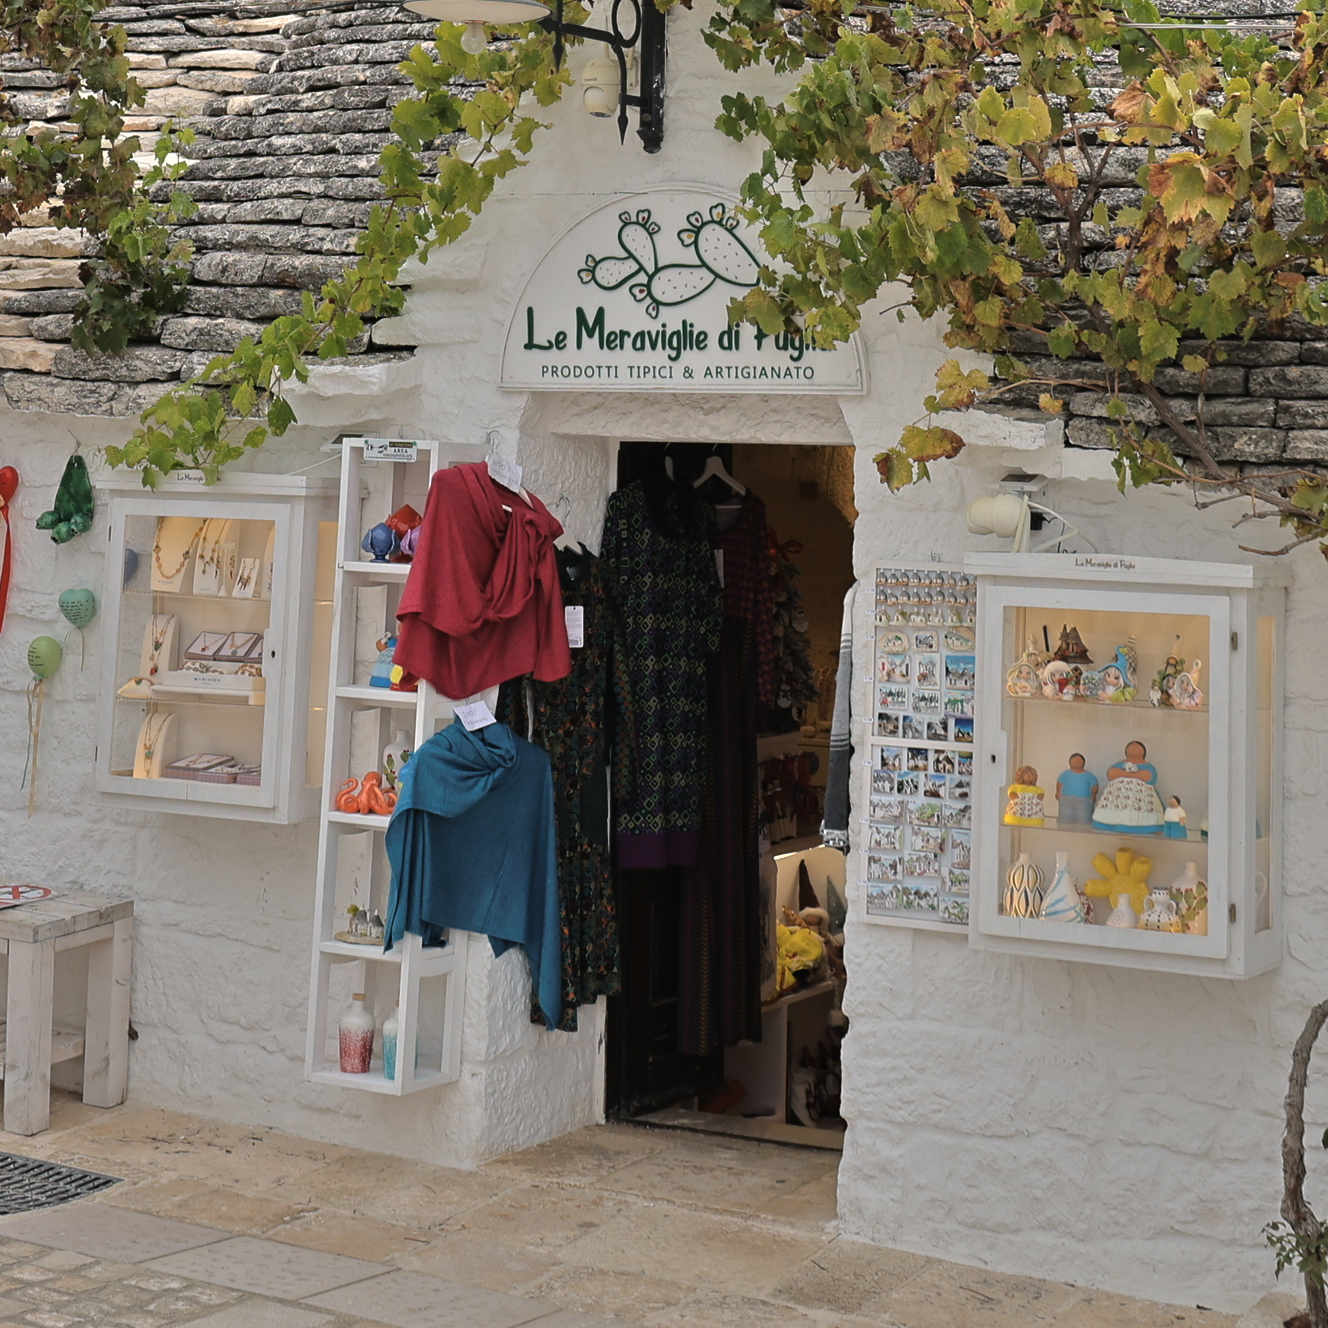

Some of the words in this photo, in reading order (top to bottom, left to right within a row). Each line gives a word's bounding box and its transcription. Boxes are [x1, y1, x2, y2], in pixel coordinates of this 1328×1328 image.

[524, 306, 567, 350] Le
[576, 306, 708, 361] Meraviglie
[718, 321, 740, 351] di
[754, 320, 834, 362] Pug
[541, 365, 618, 378] PRODOTTI
[628, 365, 673, 379] TIPICI
[683, 366, 694, 379] &
[704, 366, 815, 379] ARTIGIANATO
